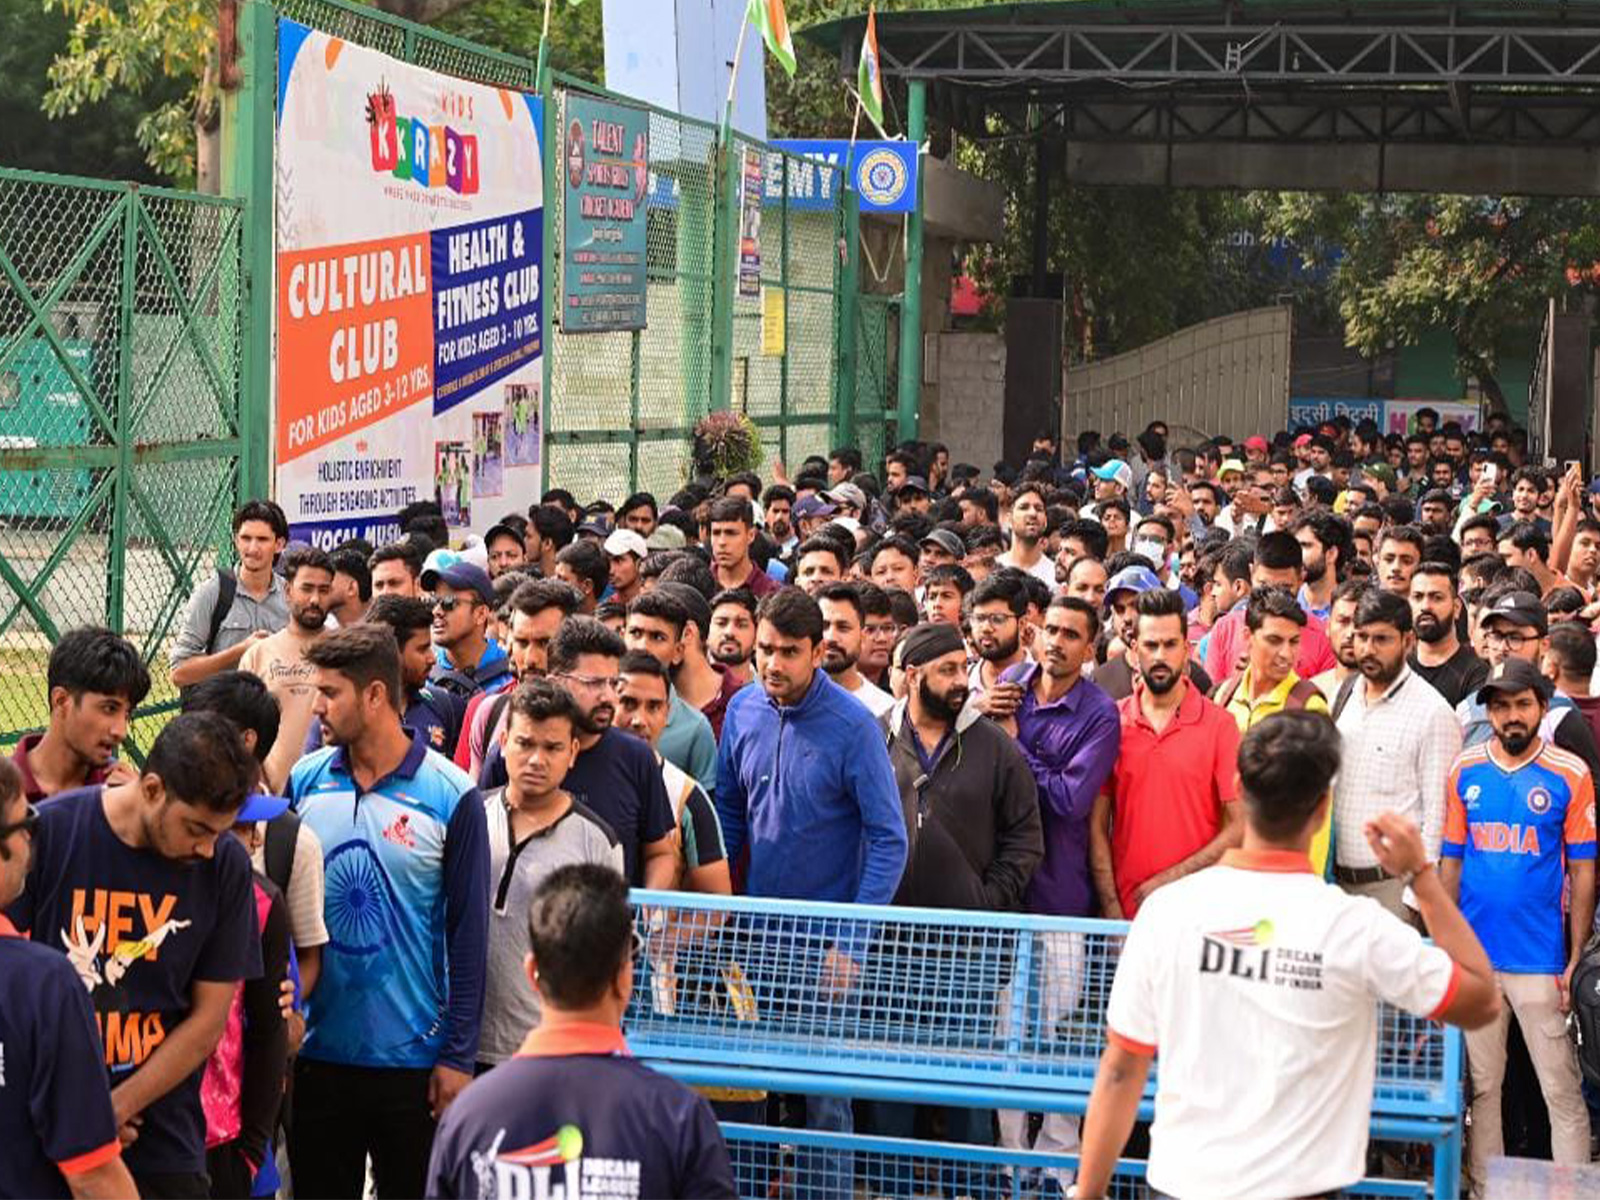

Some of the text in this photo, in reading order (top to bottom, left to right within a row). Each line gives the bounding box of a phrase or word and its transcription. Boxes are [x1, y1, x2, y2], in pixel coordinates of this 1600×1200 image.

[441, 91, 473, 121] KIDS
[373, 113, 476, 185] KKRAZY
[450, 220, 524, 273] HEALTH &
[288, 245, 427, 319] CULTURAL
[438, 265, 540, 330] FITNESS CLUB
[328, 318, 398, 383] CLUB
[438, 340, 457, 367] FOR
[457, 331, 477, 360] KIDS
[478, 323, 500, 352] AGED
[289, 418, 315, 449] FOR
[318, 402, 346, 436] KIDS
[349, 391, 381, 421] AGED
[384, 380, 408, 406] 3-12
[411, 365, 432, 393] YRS.
[299, 491, 338, 515] THROUGH
[1470, 822, 1540, 856] INDIA
[71, 888, 178, 962] HEY
[1199, 936, 1270, 981] DLI
[1275, 964, 1323, 978] LEAGUE
[1276, 948, 1323, 964] DREAM
[495, 1158, 580, 1200] DLI
[583, 1158, 640, 1177] DREAM
